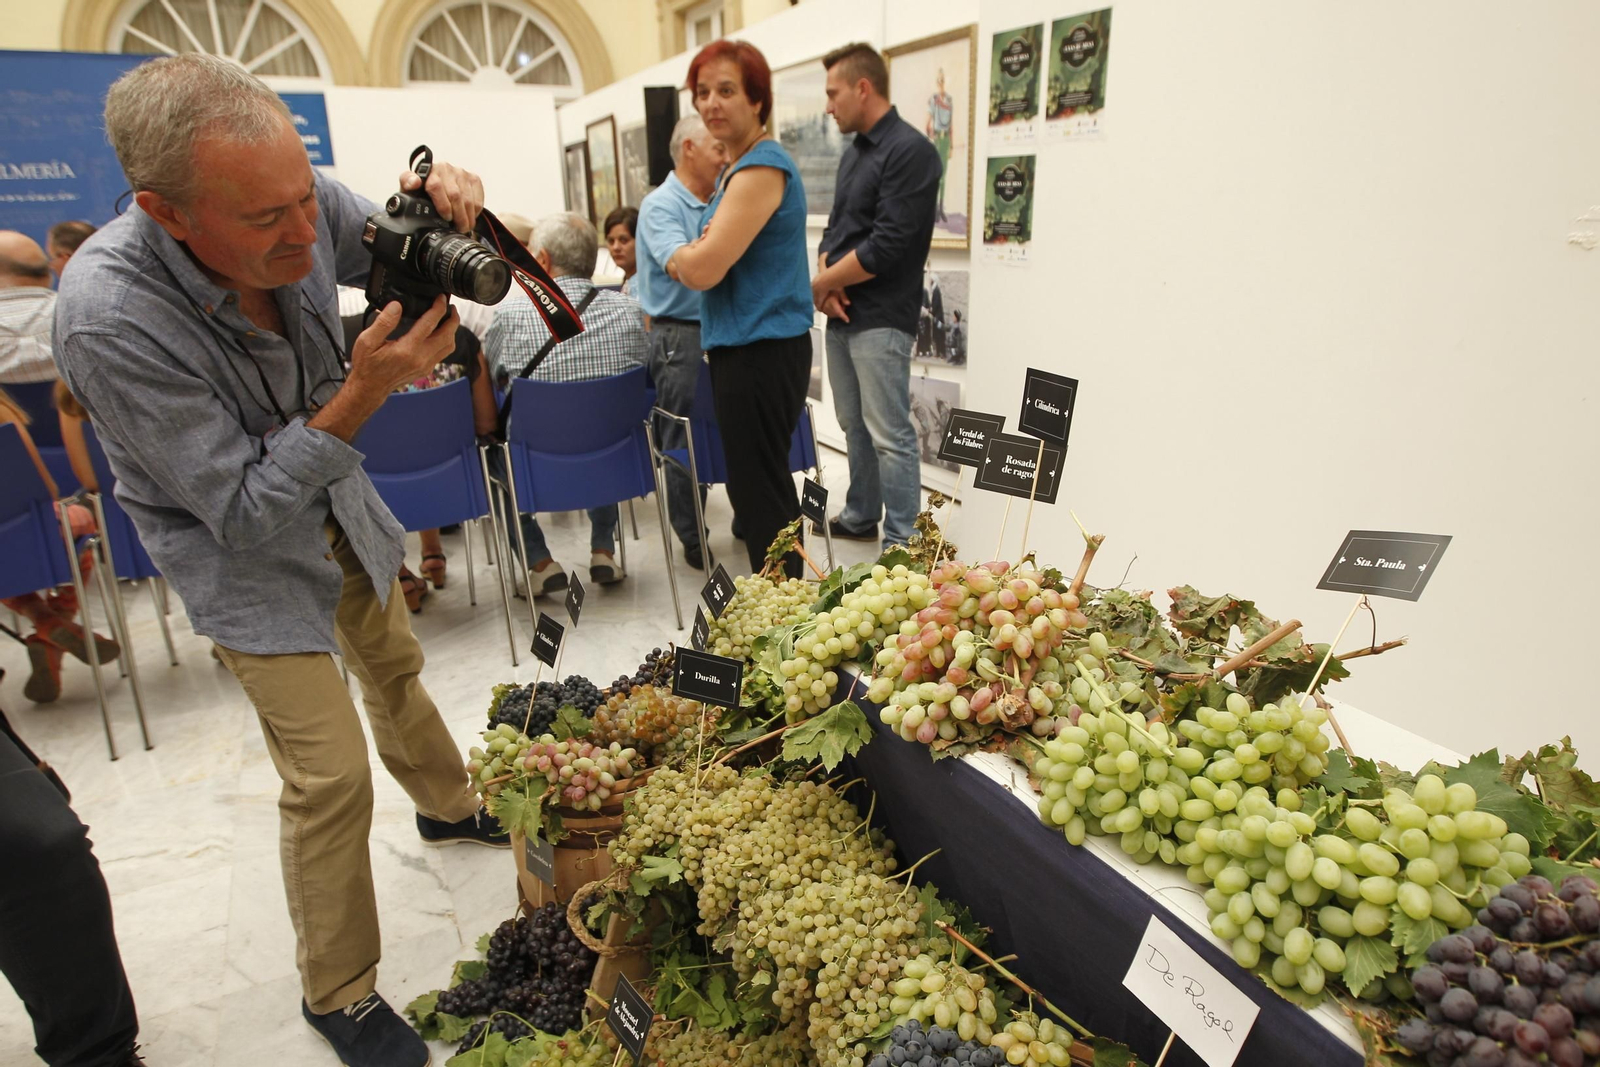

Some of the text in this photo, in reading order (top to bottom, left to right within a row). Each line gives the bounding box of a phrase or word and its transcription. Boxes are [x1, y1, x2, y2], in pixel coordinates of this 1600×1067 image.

[400, 235, 412, 260] Canon
[515, 270, 558, 314] Canon
[959, 427, 978, 439] Verdal
[961, 437, 984, 450] Filabre
[1005, 454, 1036, 469] Rosada
[1001, 464, 1013, 475] de
[1353, 556, 1407, 570] Sta. Paula
[694, 671, 721, 685] Durilla
[1145, 943, 1174, 988] De
